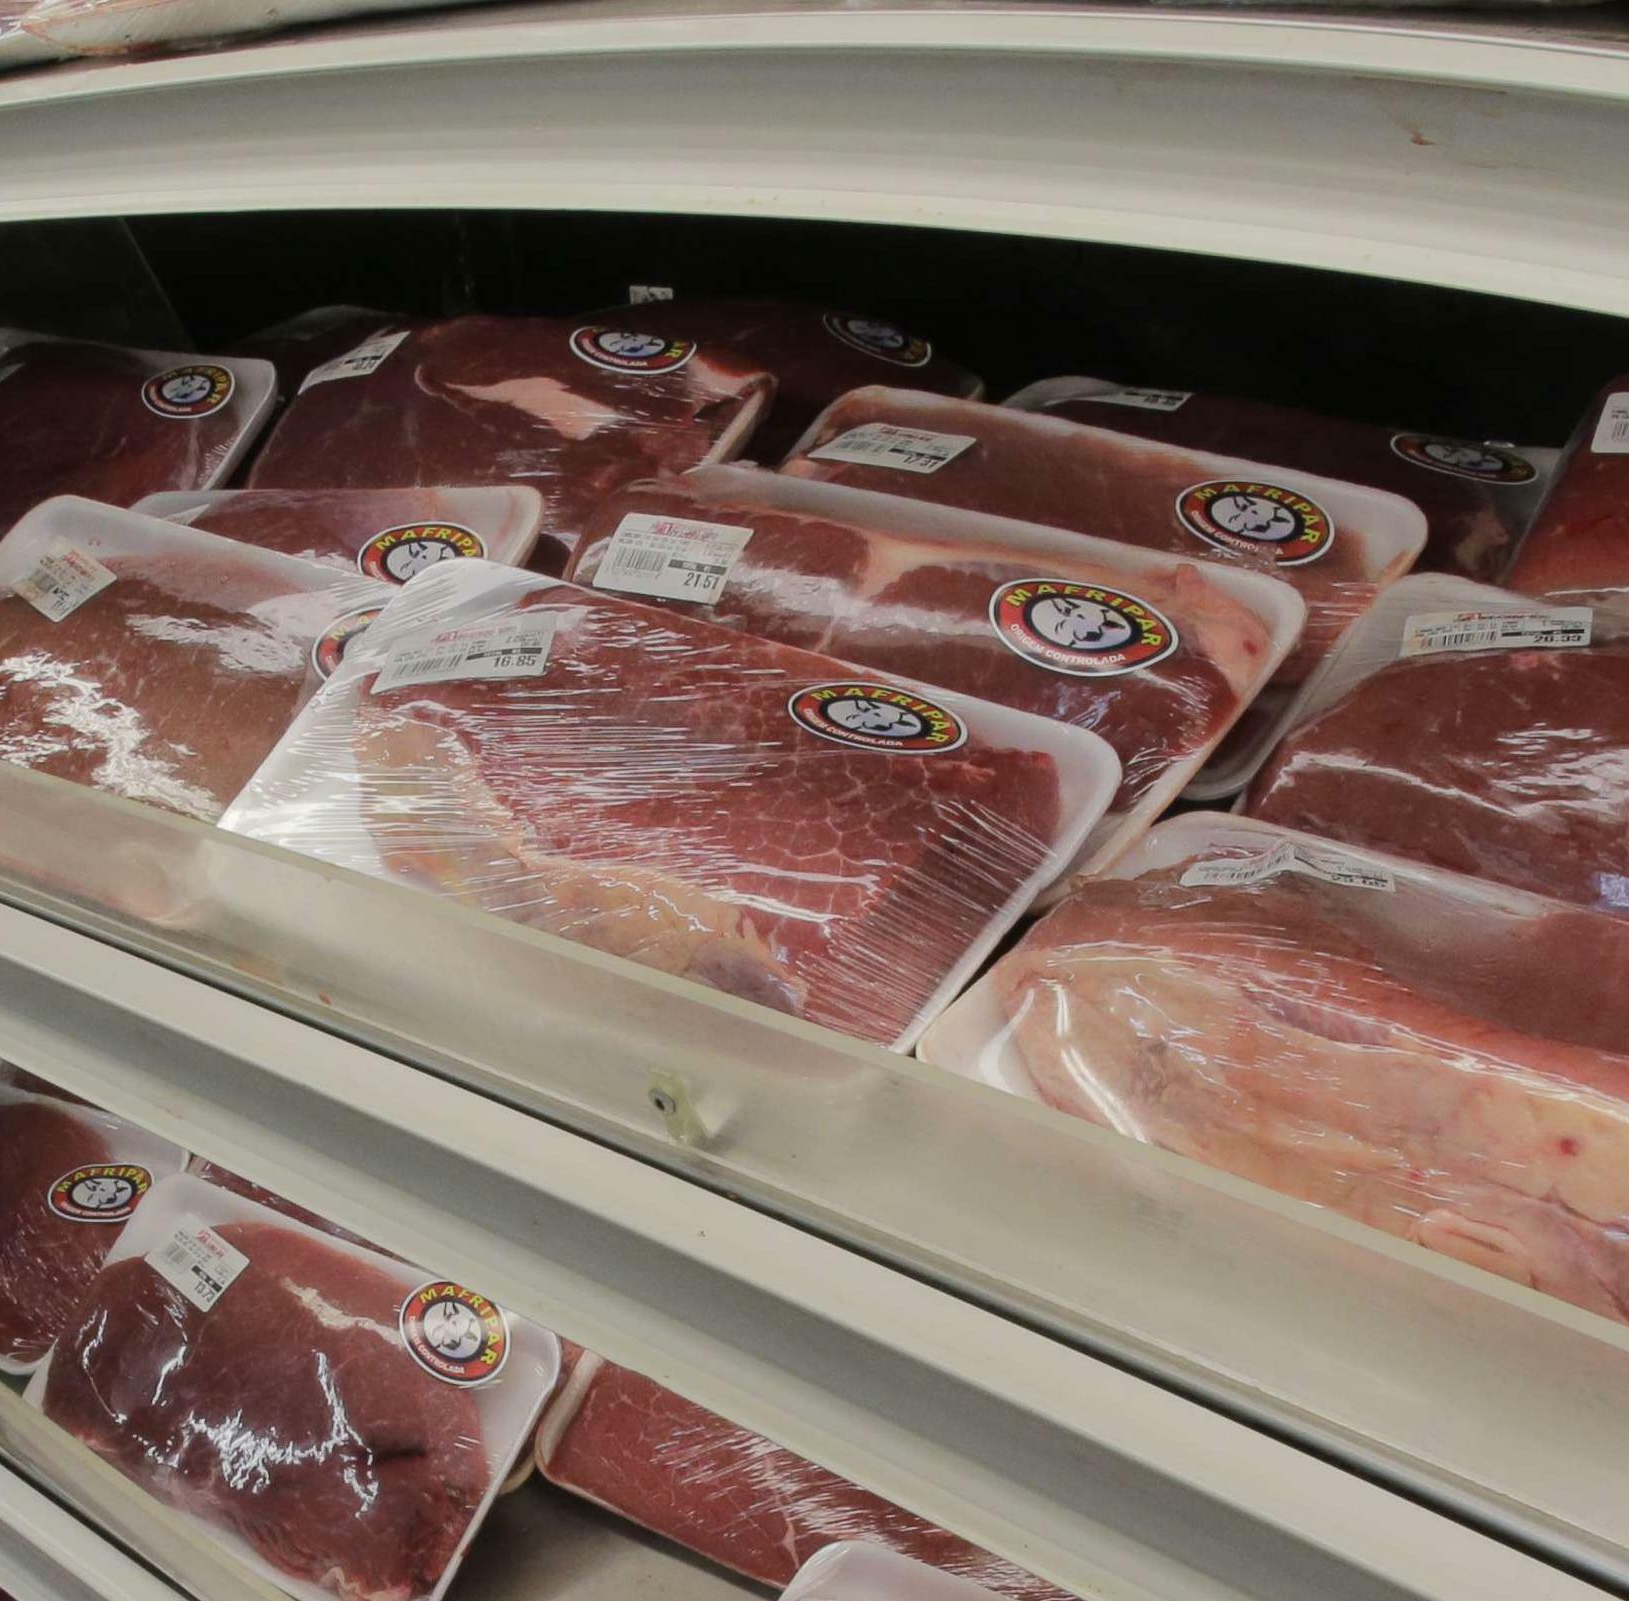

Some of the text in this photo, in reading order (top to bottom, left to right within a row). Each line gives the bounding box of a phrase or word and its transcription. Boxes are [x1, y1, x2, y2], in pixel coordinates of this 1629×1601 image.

[1194, 484, 1321, 543] MAFRIPAR
[375, 527, 481, 557] MAFRIPA
[1005, 584, 1161, 647] MAFRIPAR
[1010, 624, 1127, 665] ORIGEM CONTROLADA
[811, 687, 950, 743] MAFRIPAR
[57, 1167, 148, 1194] MAFRIPAR
[419, 1285, 502, 1366] MAFRIPAR
